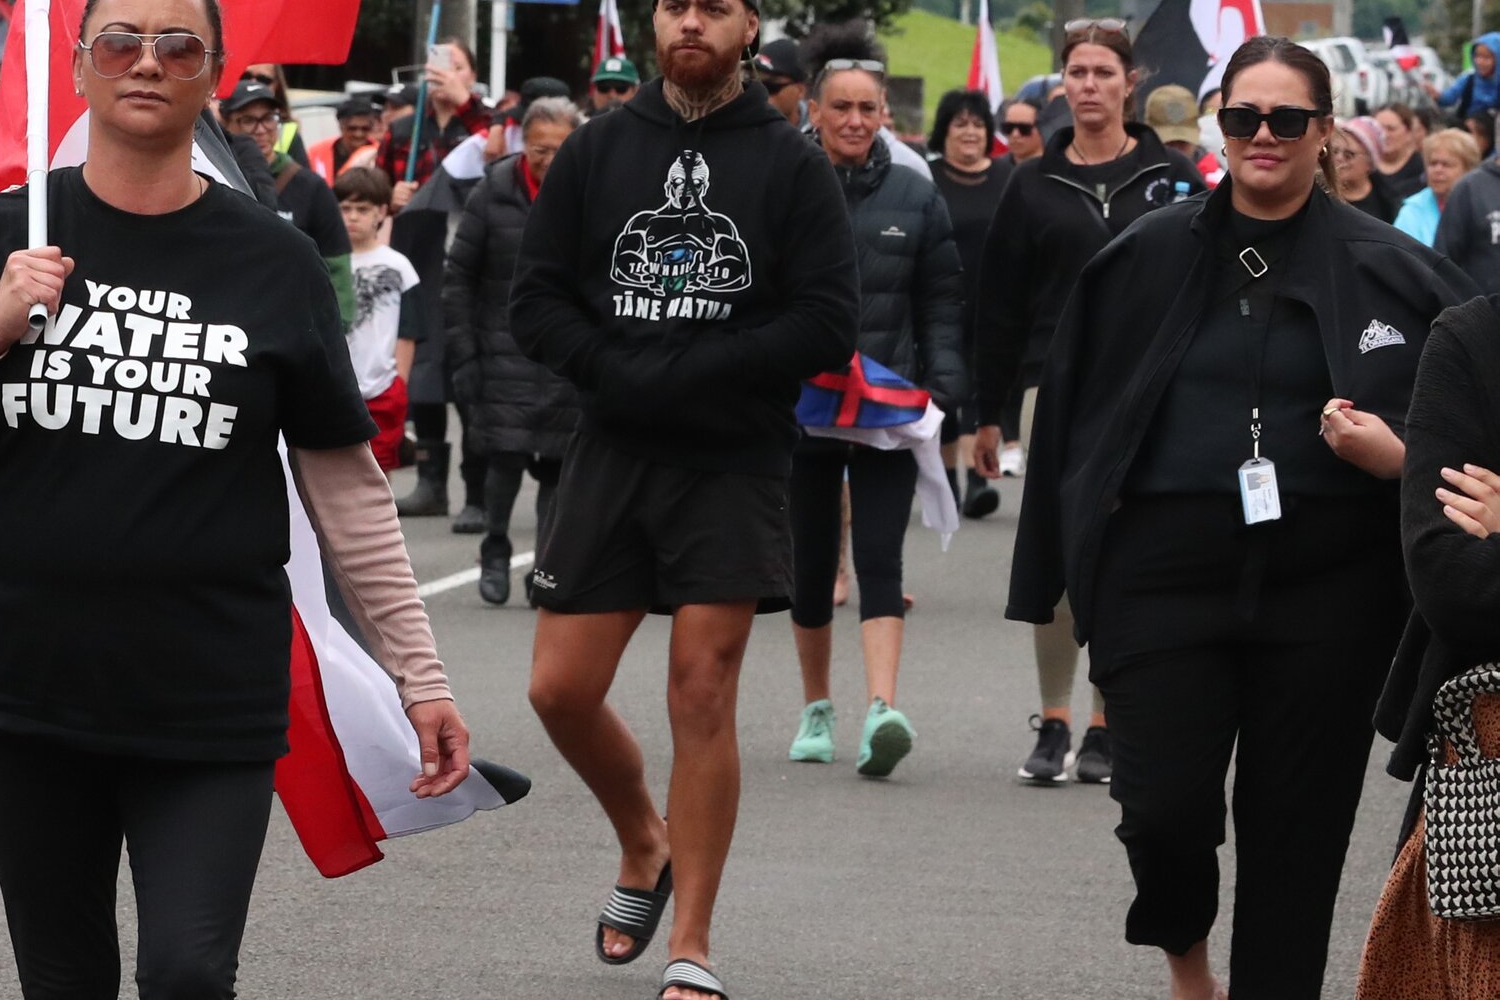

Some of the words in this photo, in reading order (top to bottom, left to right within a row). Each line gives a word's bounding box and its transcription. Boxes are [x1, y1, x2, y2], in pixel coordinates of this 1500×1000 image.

[85, 279, 192, 320] YOUR
[613, 290, 662, 321] TĀNE
[20, 303, 249, 367] WATER
[30, 349, 73, 381] IS
[86, 354, 212, 397] YOUR
[2, 382, 238, 450] FUTURE
